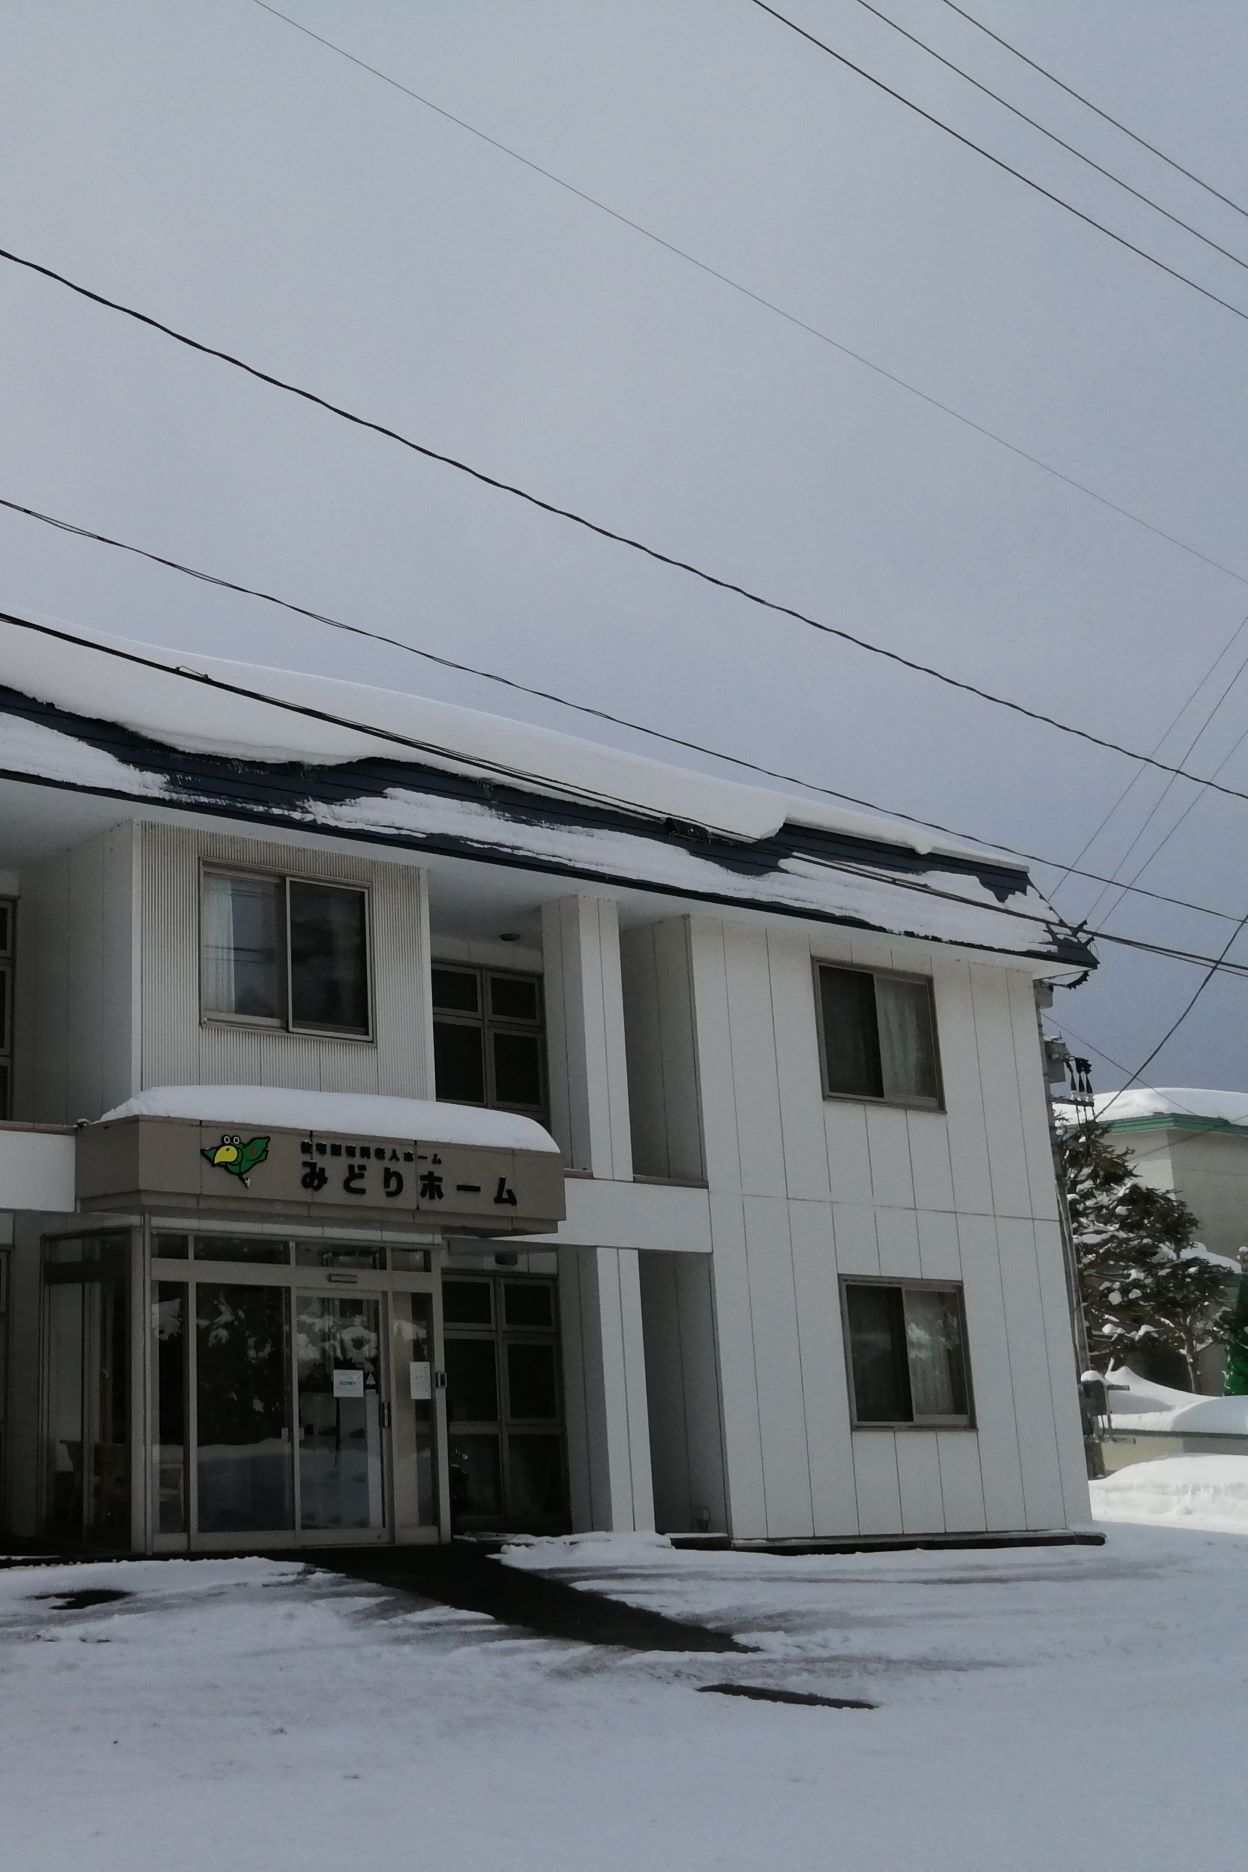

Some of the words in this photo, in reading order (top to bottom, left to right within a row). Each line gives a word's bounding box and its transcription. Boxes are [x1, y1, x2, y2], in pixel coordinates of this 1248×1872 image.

[302, 1161, 517, 1206] みどりホーム
